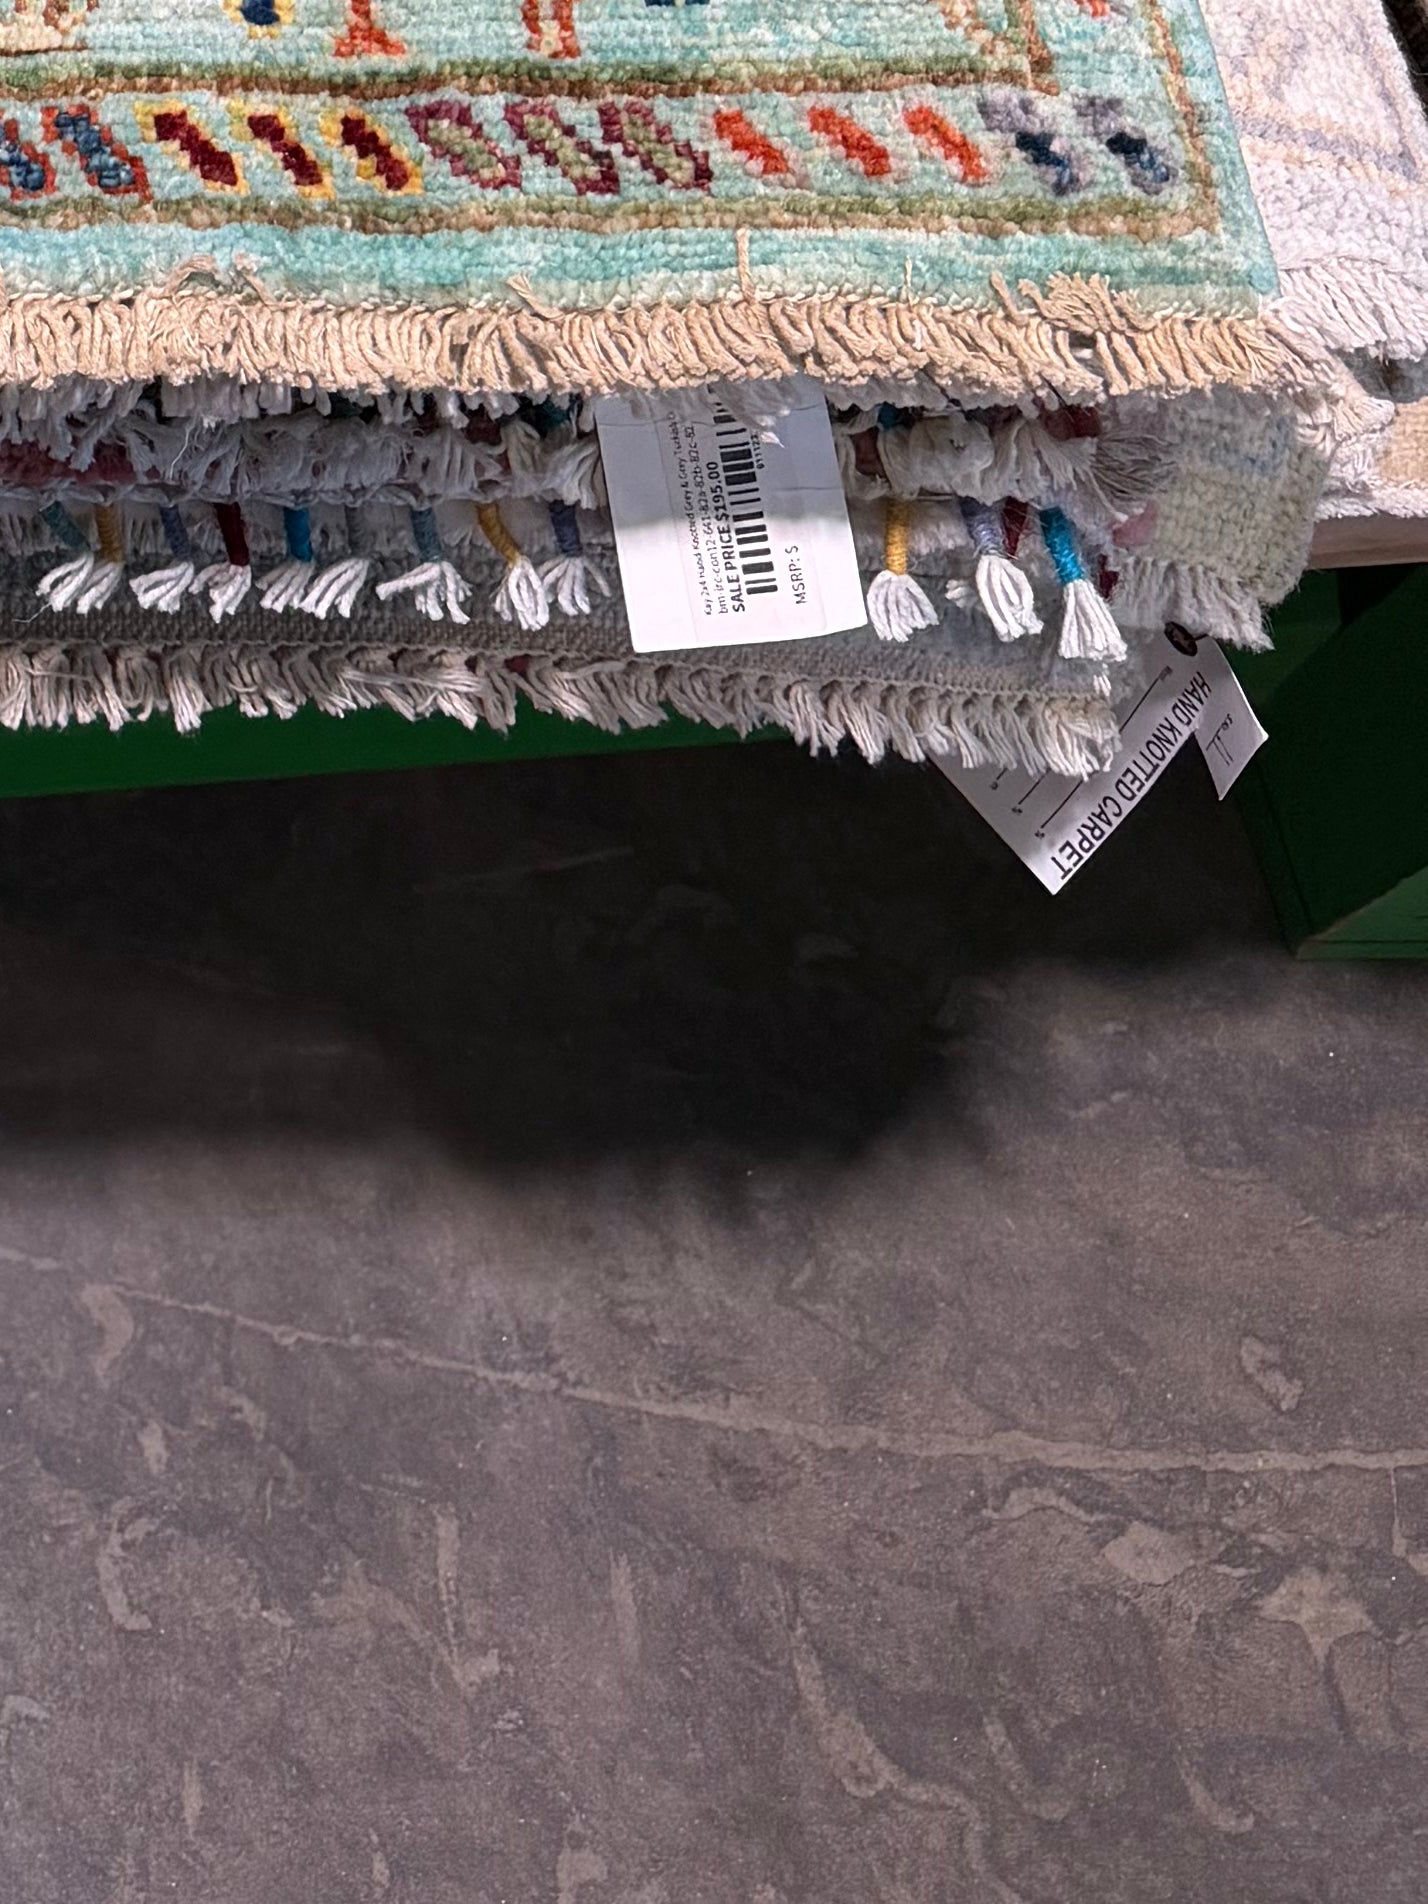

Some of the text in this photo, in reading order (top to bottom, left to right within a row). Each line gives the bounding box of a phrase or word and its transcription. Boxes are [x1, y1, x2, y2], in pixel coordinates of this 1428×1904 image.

[707, 461, 745, 612] SALE PRICE $195.00
[789, 558, 806, 604] MSRP:
[1049, 671, 1212, 880] HAND KNOTTED CARPET
